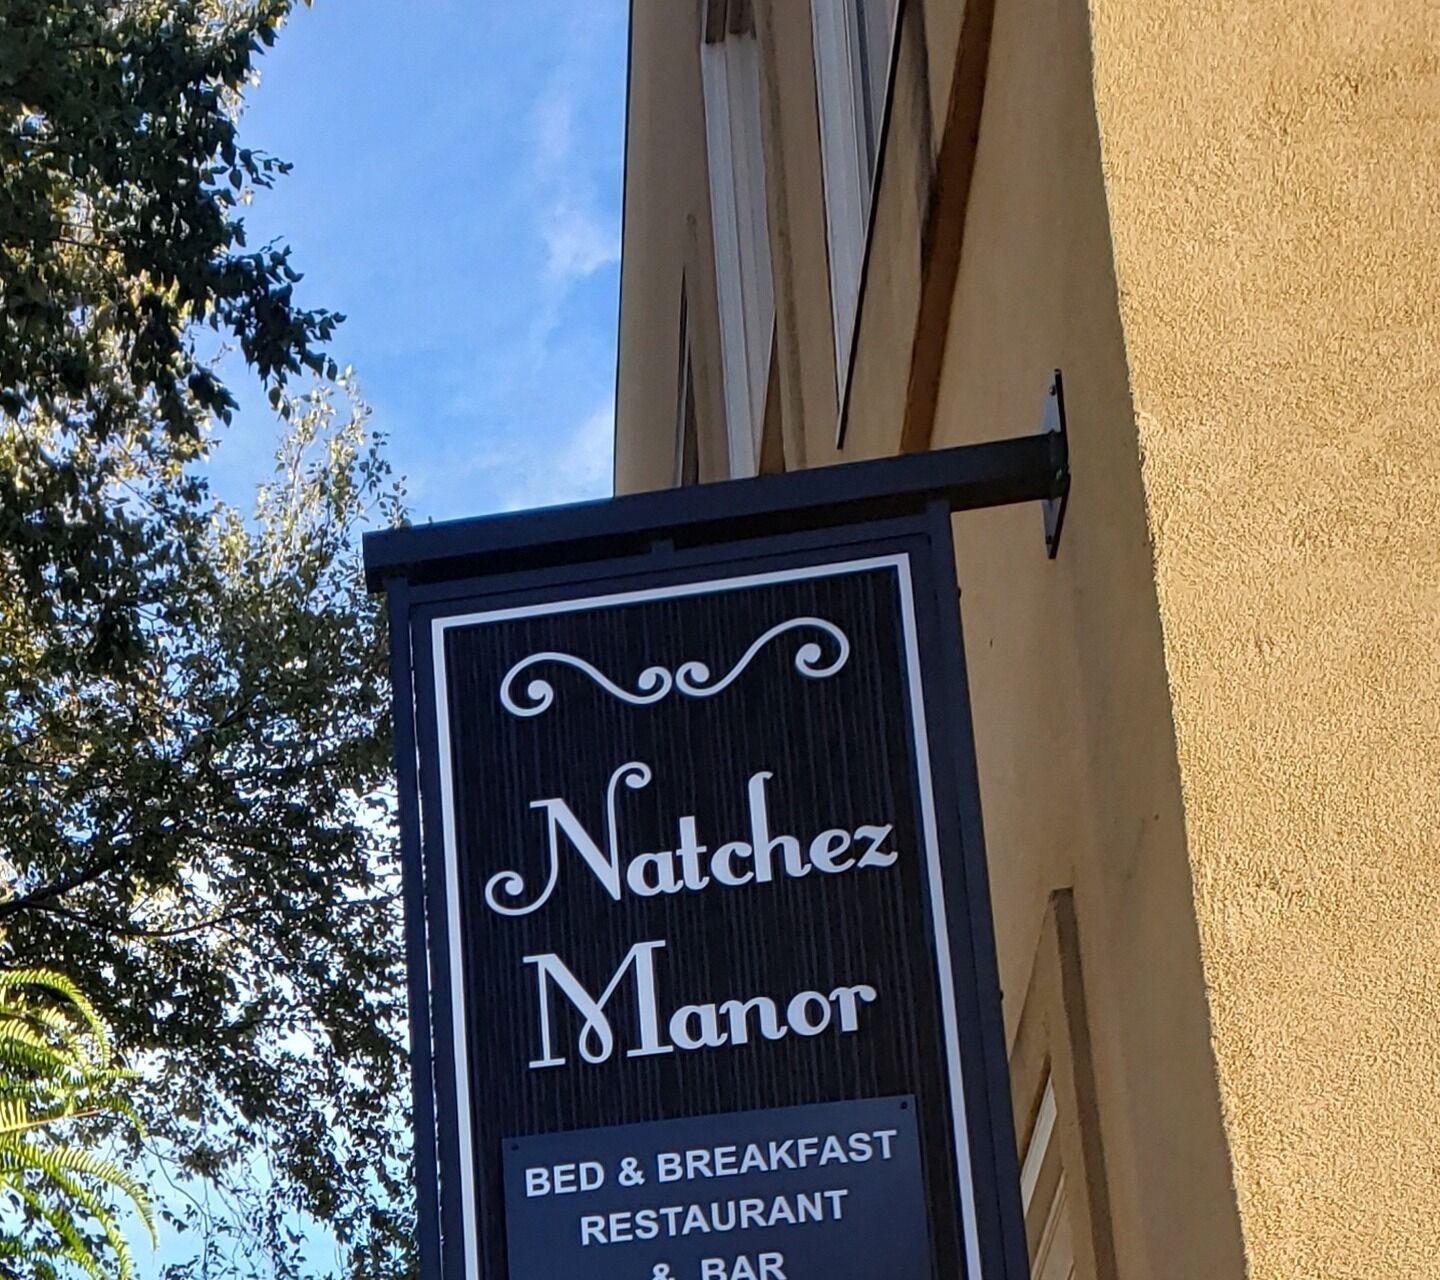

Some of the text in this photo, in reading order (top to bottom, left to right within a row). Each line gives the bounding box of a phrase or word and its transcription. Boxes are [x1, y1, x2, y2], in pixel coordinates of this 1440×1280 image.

[485, 761, 899, 916] Natchez
[522, 939, 877, 1069] Manor
[525, 1129, 898, 1197] BED & BREAKFAST
[580, 1188, 849, 1246] RESTAURANT
